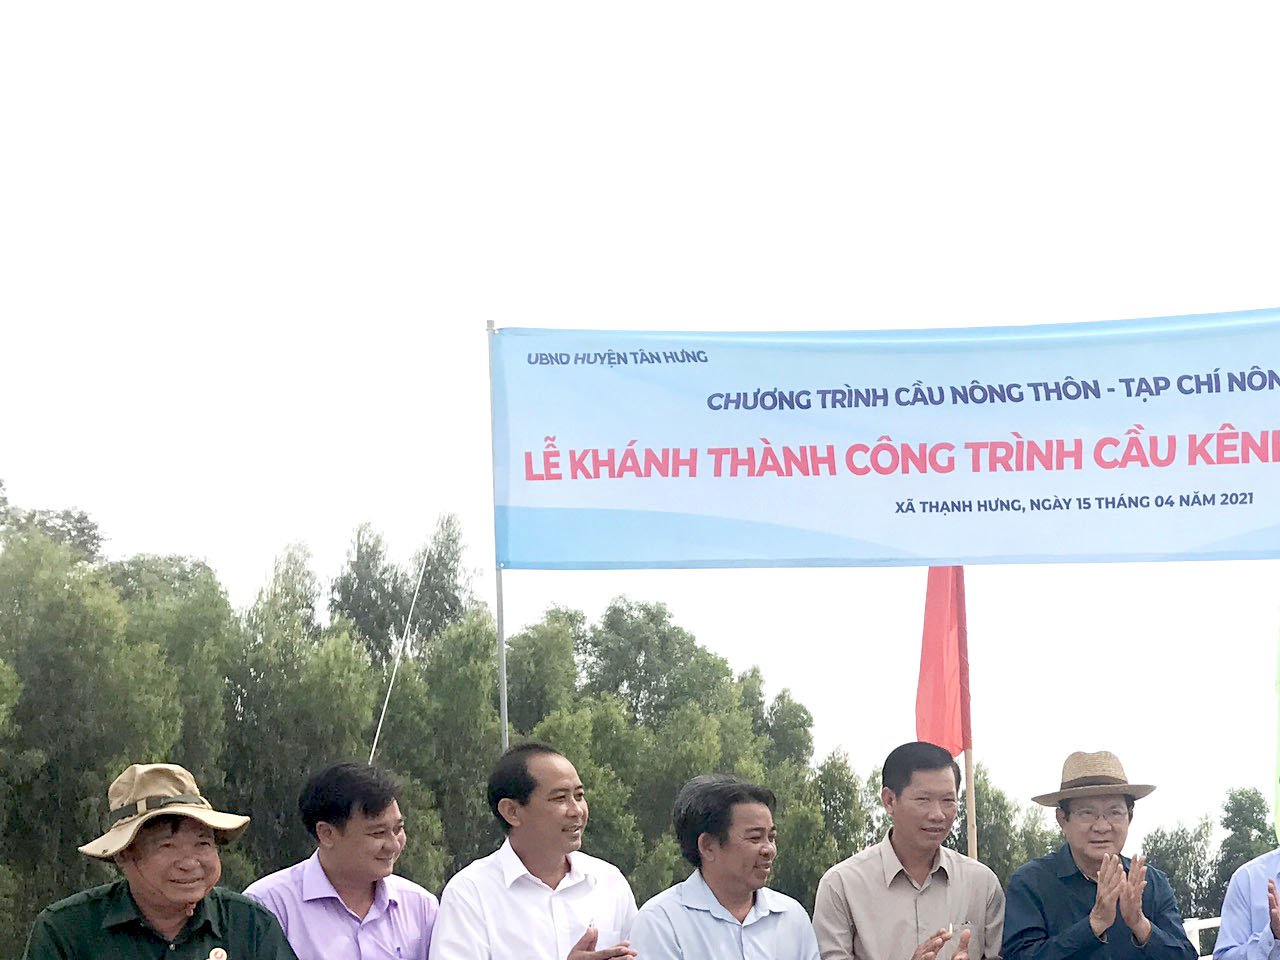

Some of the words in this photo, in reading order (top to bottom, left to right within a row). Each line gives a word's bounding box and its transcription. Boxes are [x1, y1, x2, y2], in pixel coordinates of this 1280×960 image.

[528, 352, 570, 366] UBND
[574, 348, 628, 369] HUYỆN
[630, 348, 661, 365] TÂN
[663, 348, 708, 364] HƯNG
[707, 387, 811, 411] CHƯƠNG
[818, 383, 888, 409] TRÌNH
[895, 379, 944, 407] CẦU
[950, 379, 1024, 405] NÔNG
[1027, 375, 1100, 402] THÔN
[1119, 376, 1170, 403] TẠP
[1177, 369, 1220, 395] CHÍ
[525, 435, 562, 482] LỄ
[569, 439, 697, 480] KHÁNH
[707, 437, 836, 478] THÀNH
[846, 435, 955, 476] CÔNG
[964, 431, 1082, 473] TRÌNH
[1093, 423, 1176, 470] CẦU
[896, 498, 915, 514] XÃ
[920, 500, 972, 516] THẠNH
[977, 497, 1025, 514] HƯNG,
[1030, 497, 1071, 511] NGÀY
[1076, 497, 1090, 510] 15
[1095, 495, 1149, 510] THÁNG
[1155, 495, 1174, 508] 04
[1180, 490, 1215, 507] NĂM
[1220, 491, 1253, 506] 2021
